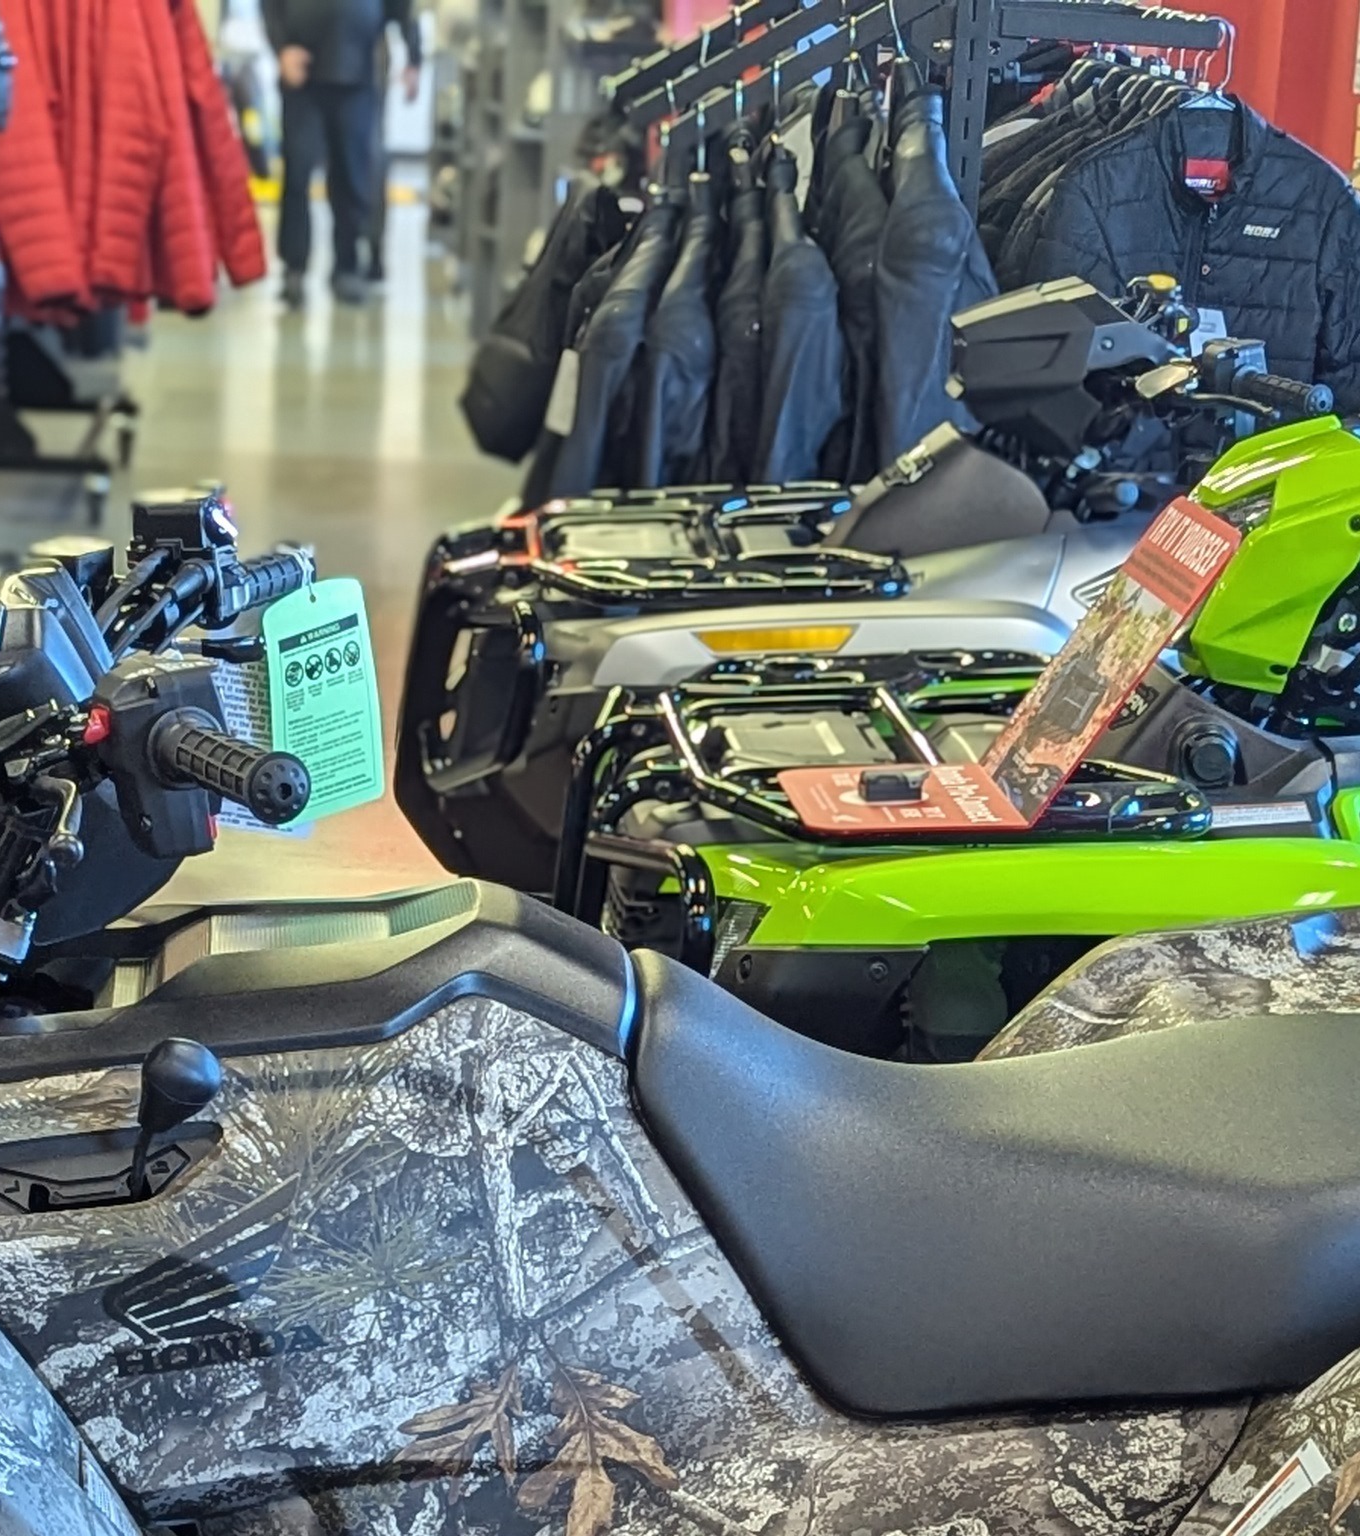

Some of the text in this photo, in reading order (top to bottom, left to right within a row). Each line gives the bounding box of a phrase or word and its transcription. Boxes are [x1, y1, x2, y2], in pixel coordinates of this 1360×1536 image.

[1148, 506, 1184, 547] TRY
[1170, 520, 1230, 577] YOURSELF
[115, 1324, 330, 1378] HONDA
